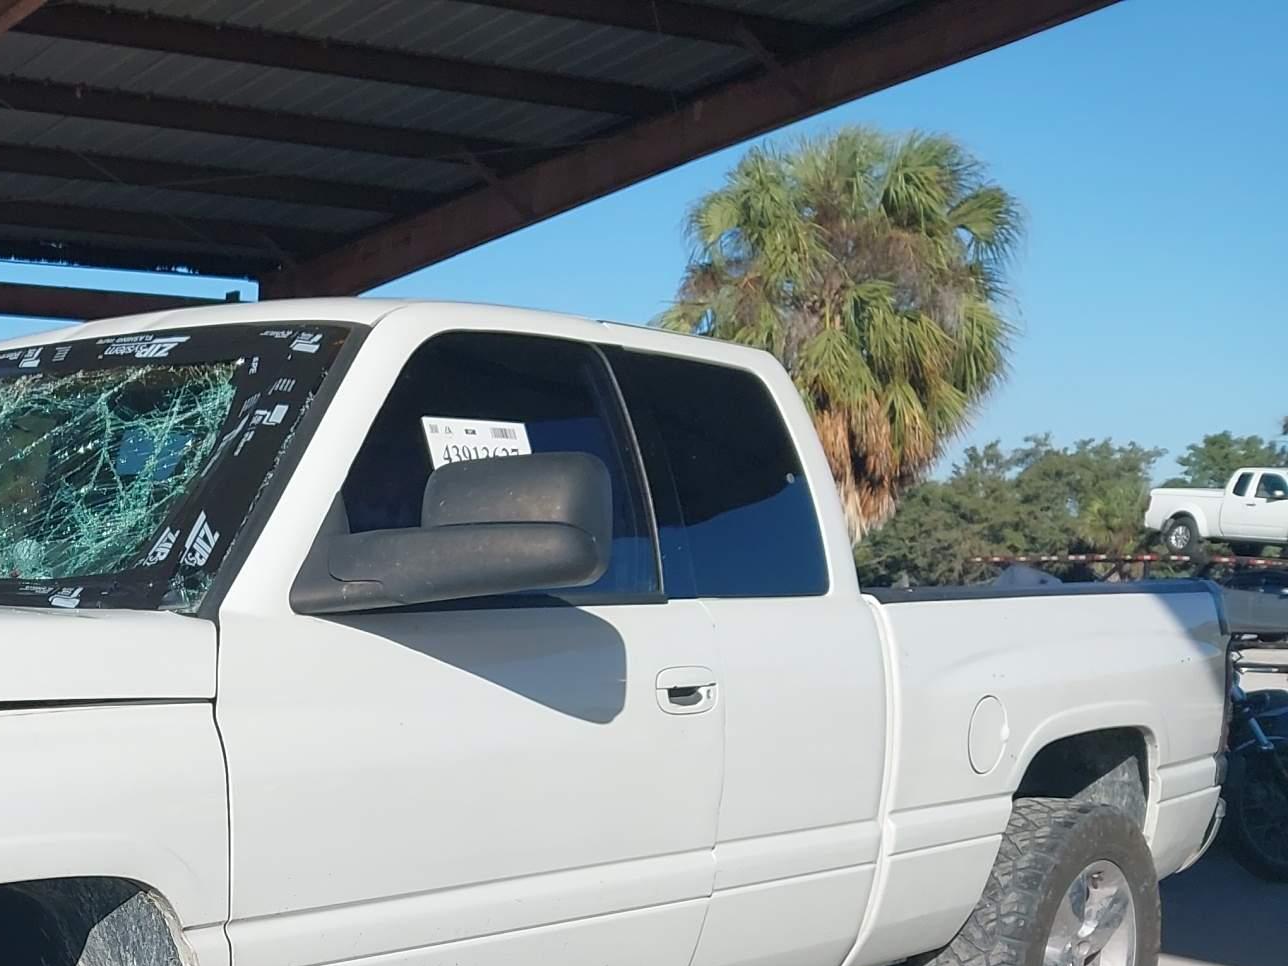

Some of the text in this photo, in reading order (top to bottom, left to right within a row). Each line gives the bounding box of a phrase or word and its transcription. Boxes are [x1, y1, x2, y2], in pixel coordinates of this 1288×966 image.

[135, 343, 178, 358] ZIP
[155, 529, 180, 561] ZIP
[193, 522, 220, 567] ZIP
